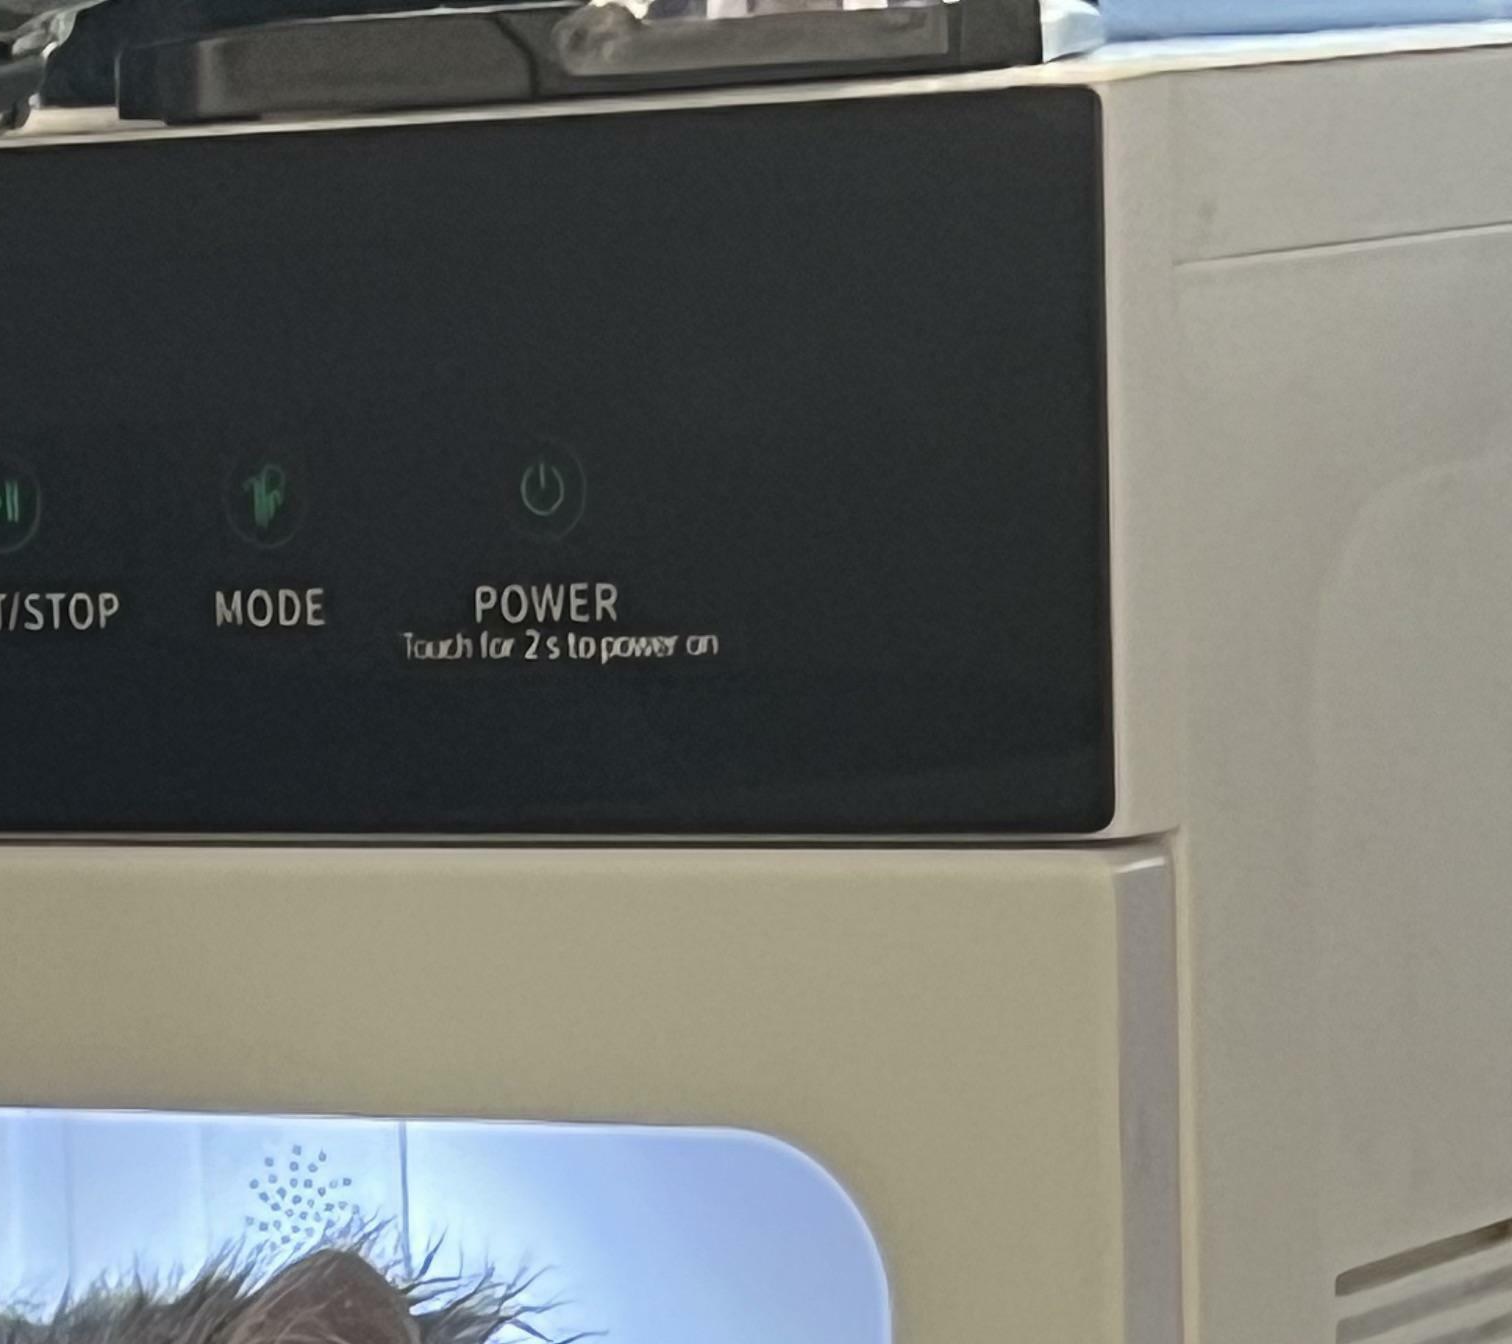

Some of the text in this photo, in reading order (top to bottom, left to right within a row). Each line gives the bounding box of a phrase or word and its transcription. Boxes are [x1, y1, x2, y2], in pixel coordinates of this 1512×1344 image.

[215, 588, 326, 628] MODE
[475, 582, 618, 623] POWER
[402, 629, 718, 664] Touch for 2 s to power on
